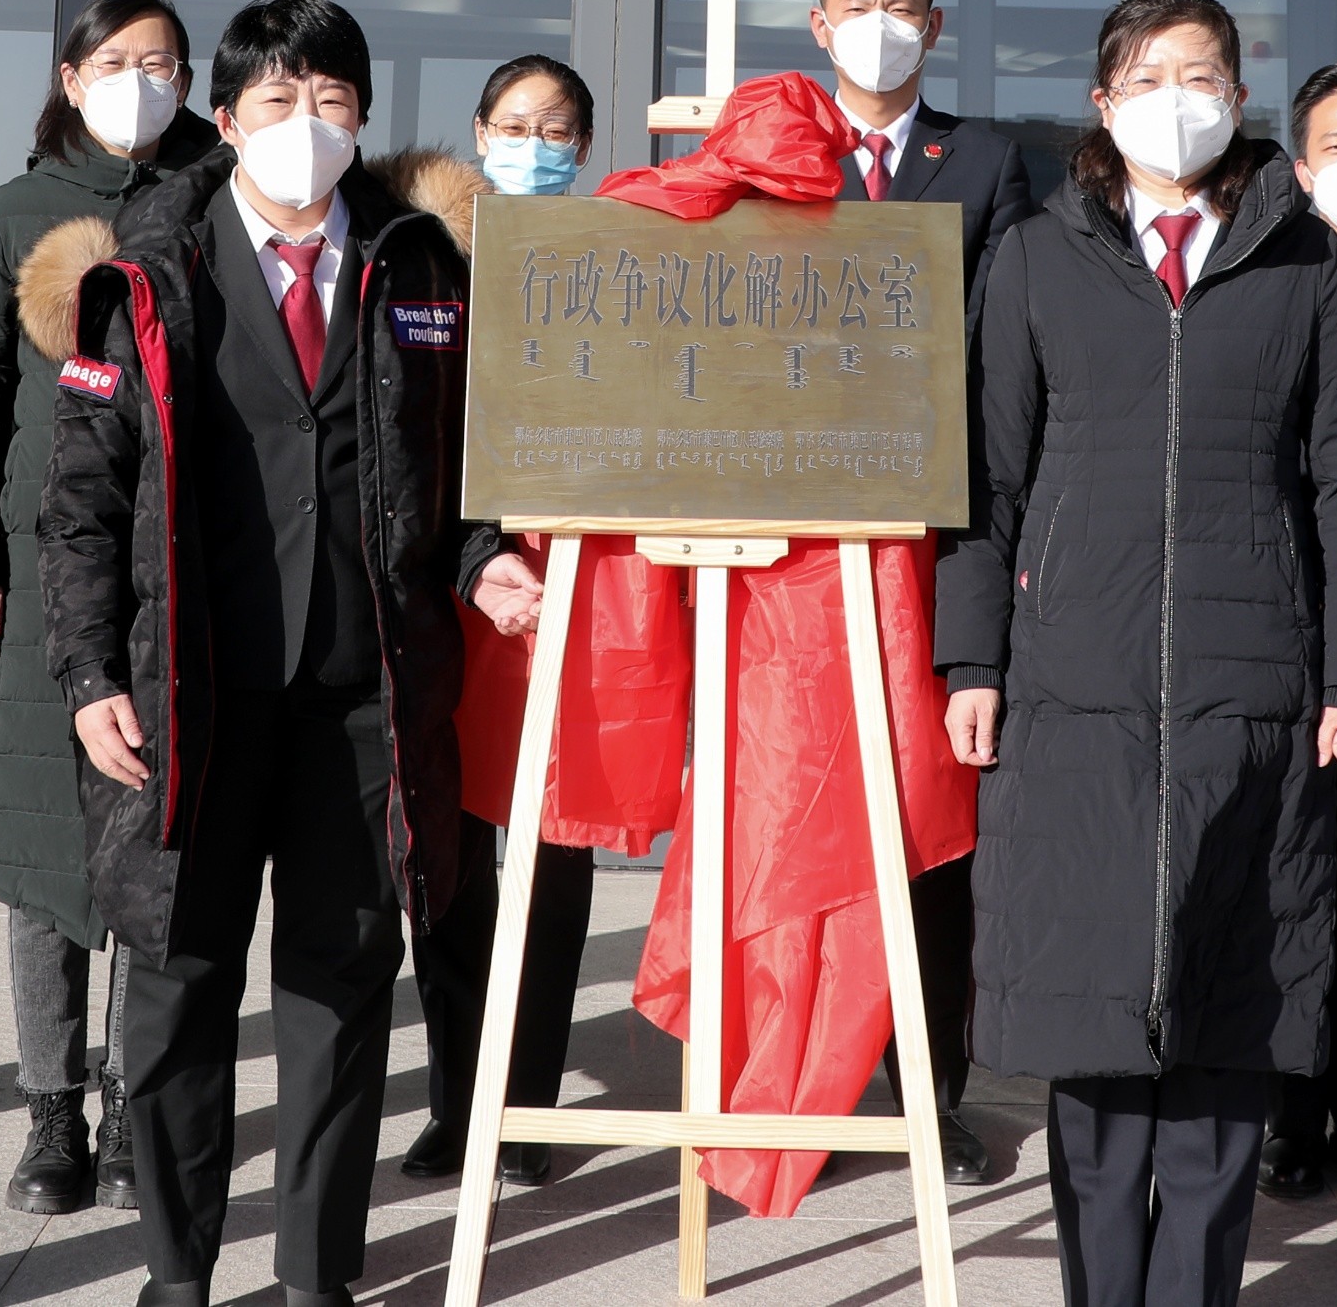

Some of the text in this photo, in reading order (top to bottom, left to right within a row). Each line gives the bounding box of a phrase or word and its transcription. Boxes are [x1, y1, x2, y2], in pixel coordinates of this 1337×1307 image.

[519, 247, 918, 329] 行政争议化解办公室
[394, 307, 456, 325] Break the
[408, 327, 451, 344] routine
[514, 426, 923, 452] 鄂尔多斯市康巴什区人民法院 鄂尔多斯市康巴什区人民检察院 鄂尔多斯市康巴什区司法局
